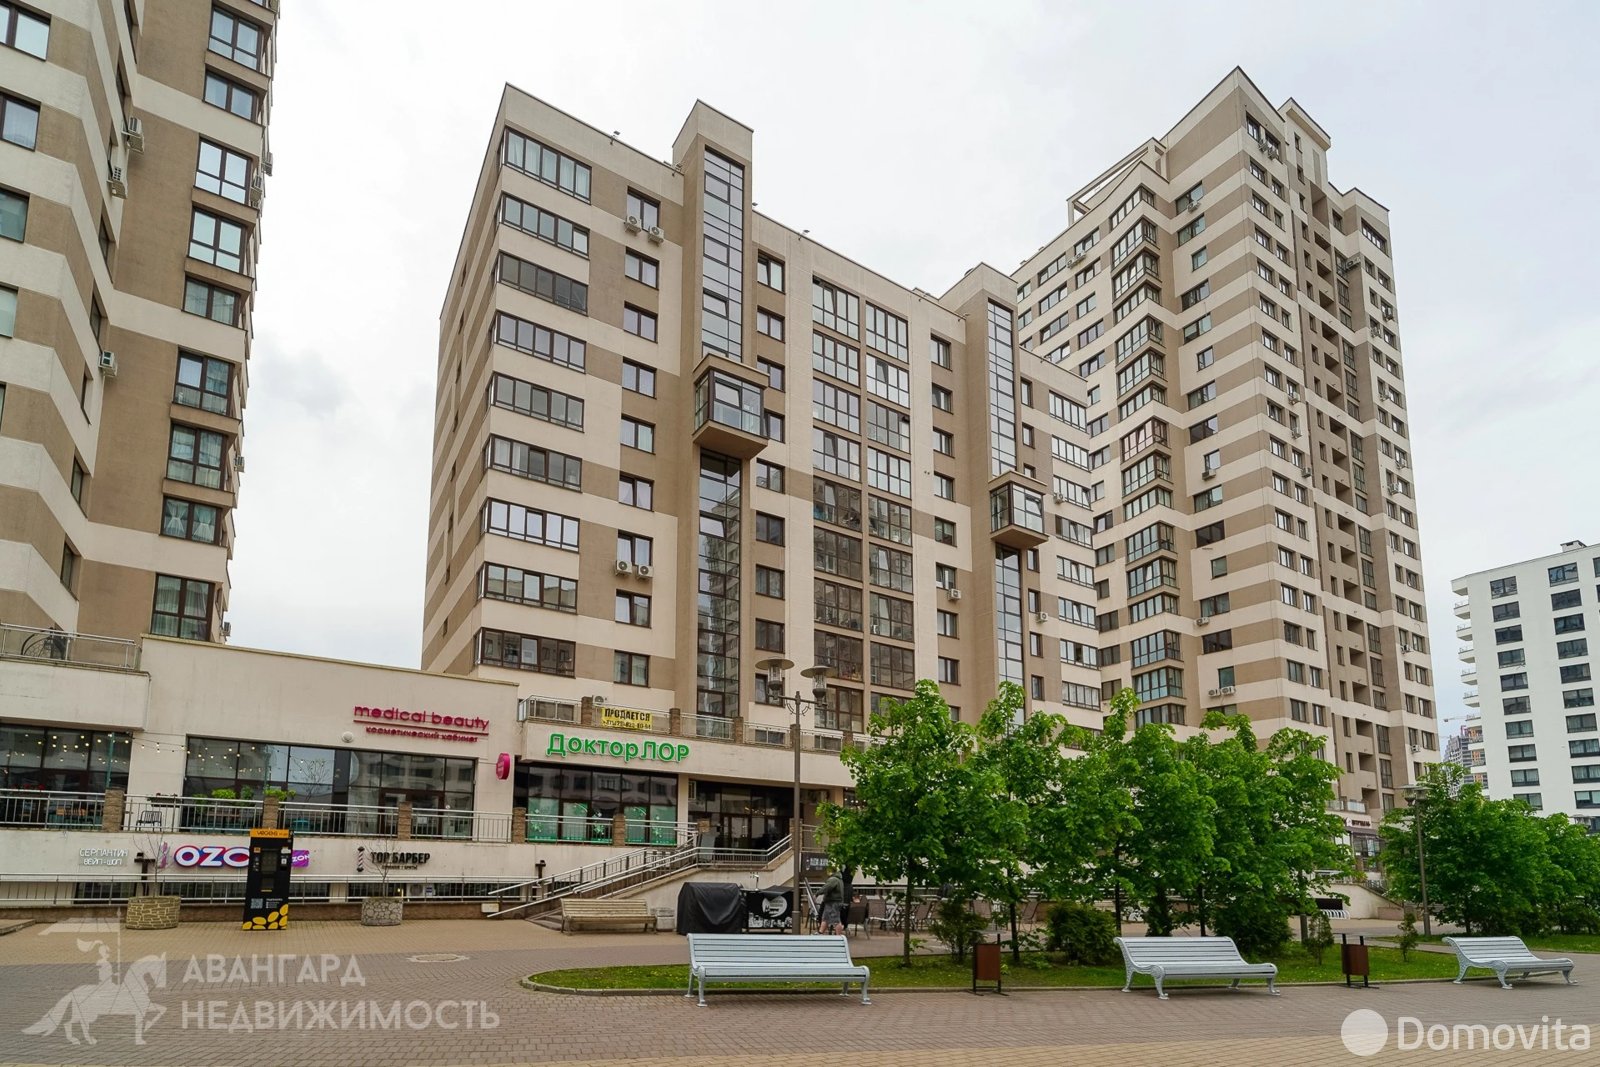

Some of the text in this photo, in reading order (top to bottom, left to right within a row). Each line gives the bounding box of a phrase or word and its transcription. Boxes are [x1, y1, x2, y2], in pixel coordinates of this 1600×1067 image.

[354, 706, 489, 731] medical beauty
[604, 708, 650, 721] ПРОДАЕТСЯ
[79, 848, 128, 857] СЕРПАНТИН
[174, 845, 250, 868] OZO
[392, 852, 431, 863] БАРБЕР
